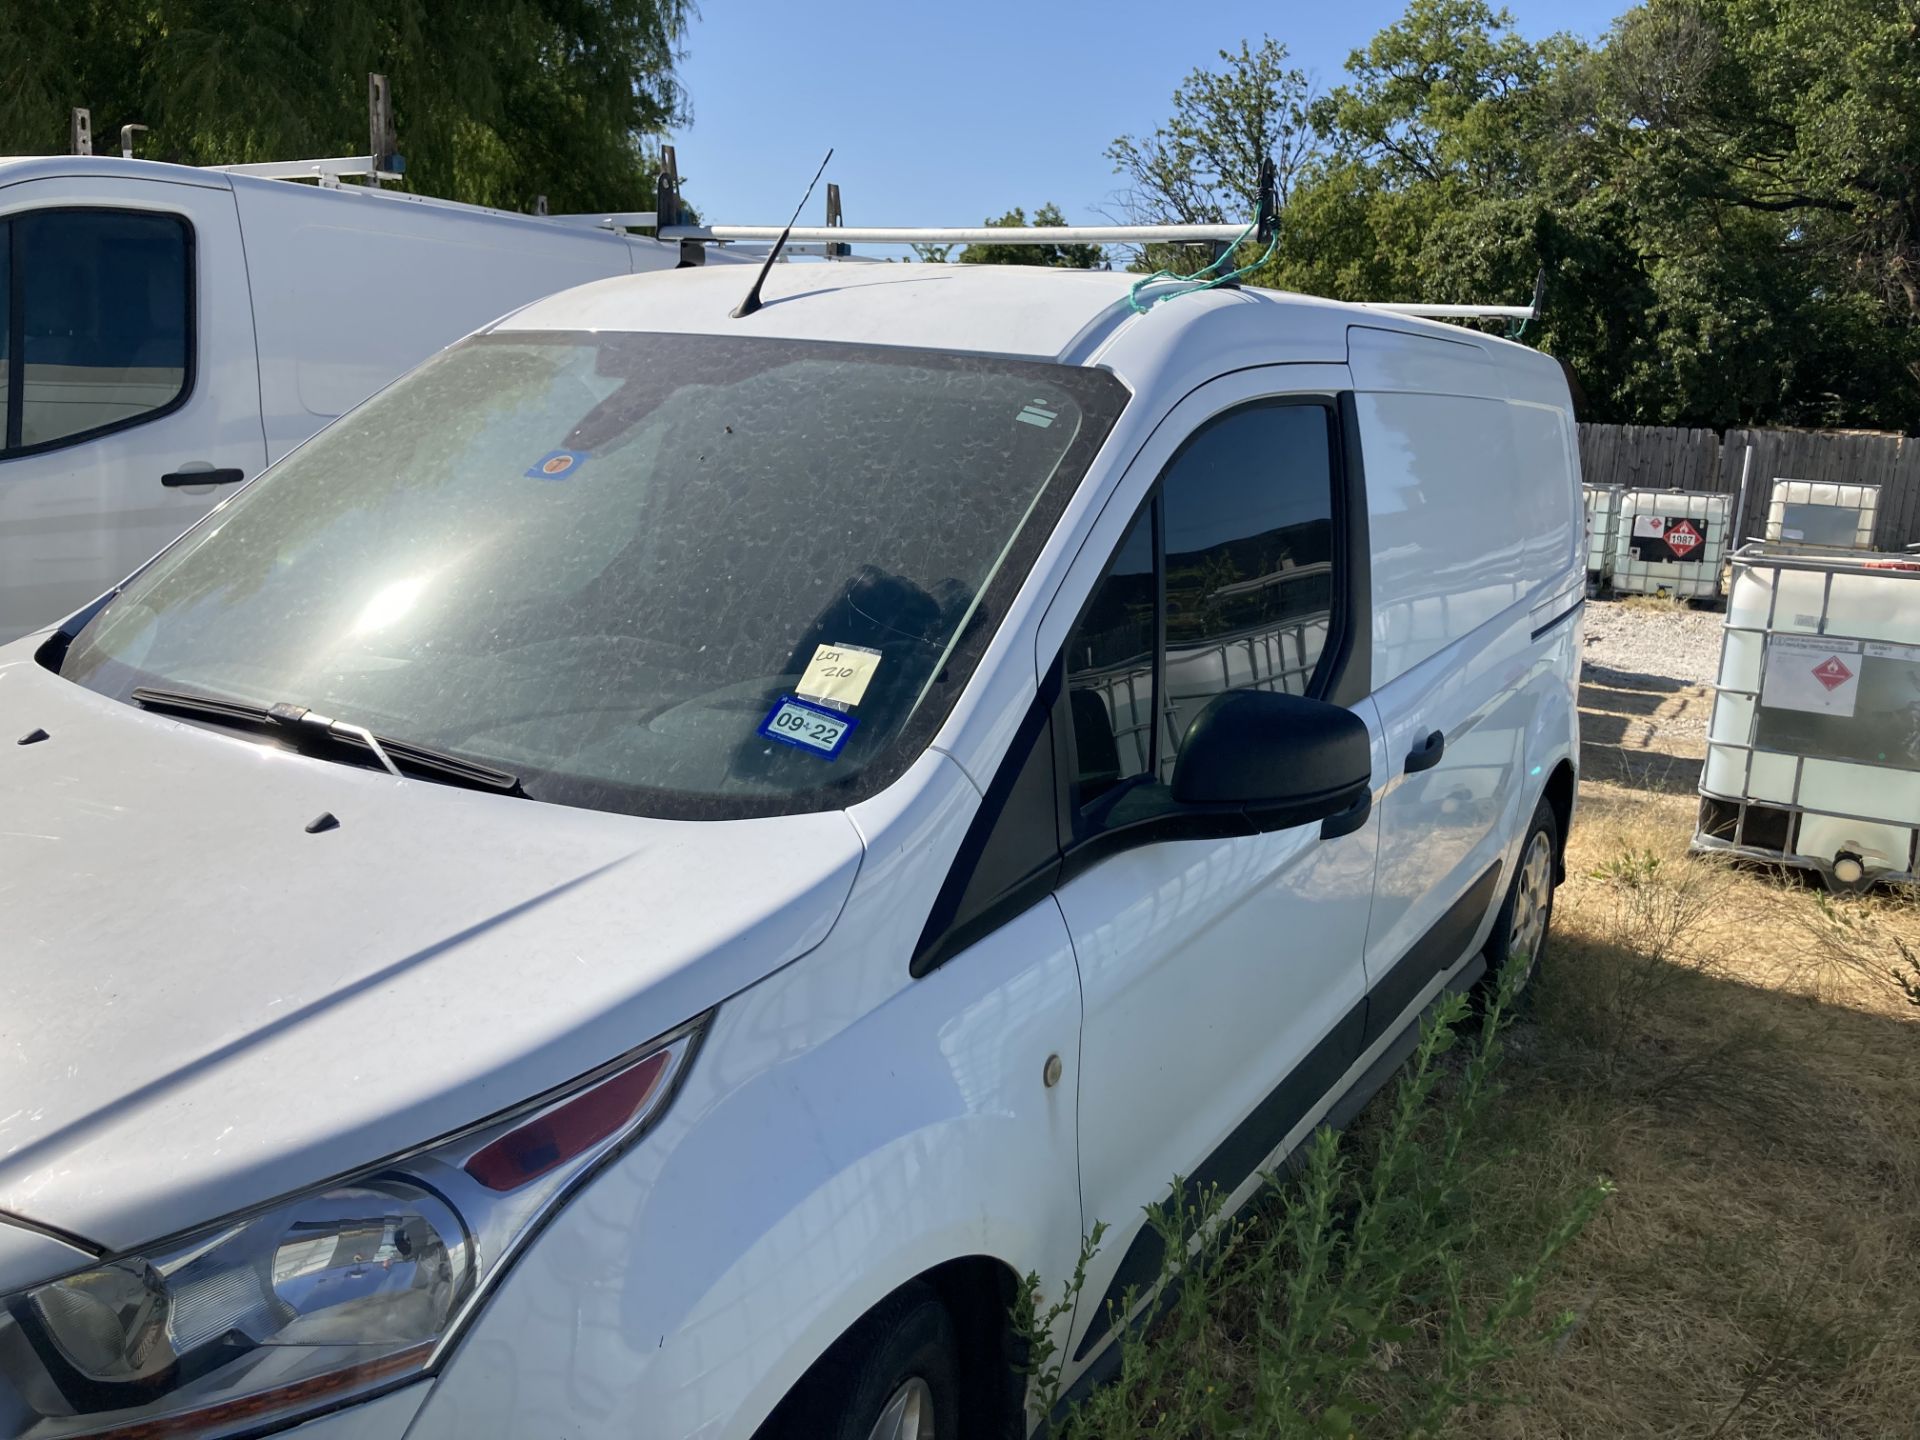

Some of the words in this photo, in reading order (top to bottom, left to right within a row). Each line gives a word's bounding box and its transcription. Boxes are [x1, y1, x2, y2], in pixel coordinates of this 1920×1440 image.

[1672, 535, 1693, 545] 1987
[816, 650, 843, 662] LOT
[821, 667, 854, 678] 210
[776, 712, 805, 732] 09
[809, 724, 839, 745] 22
